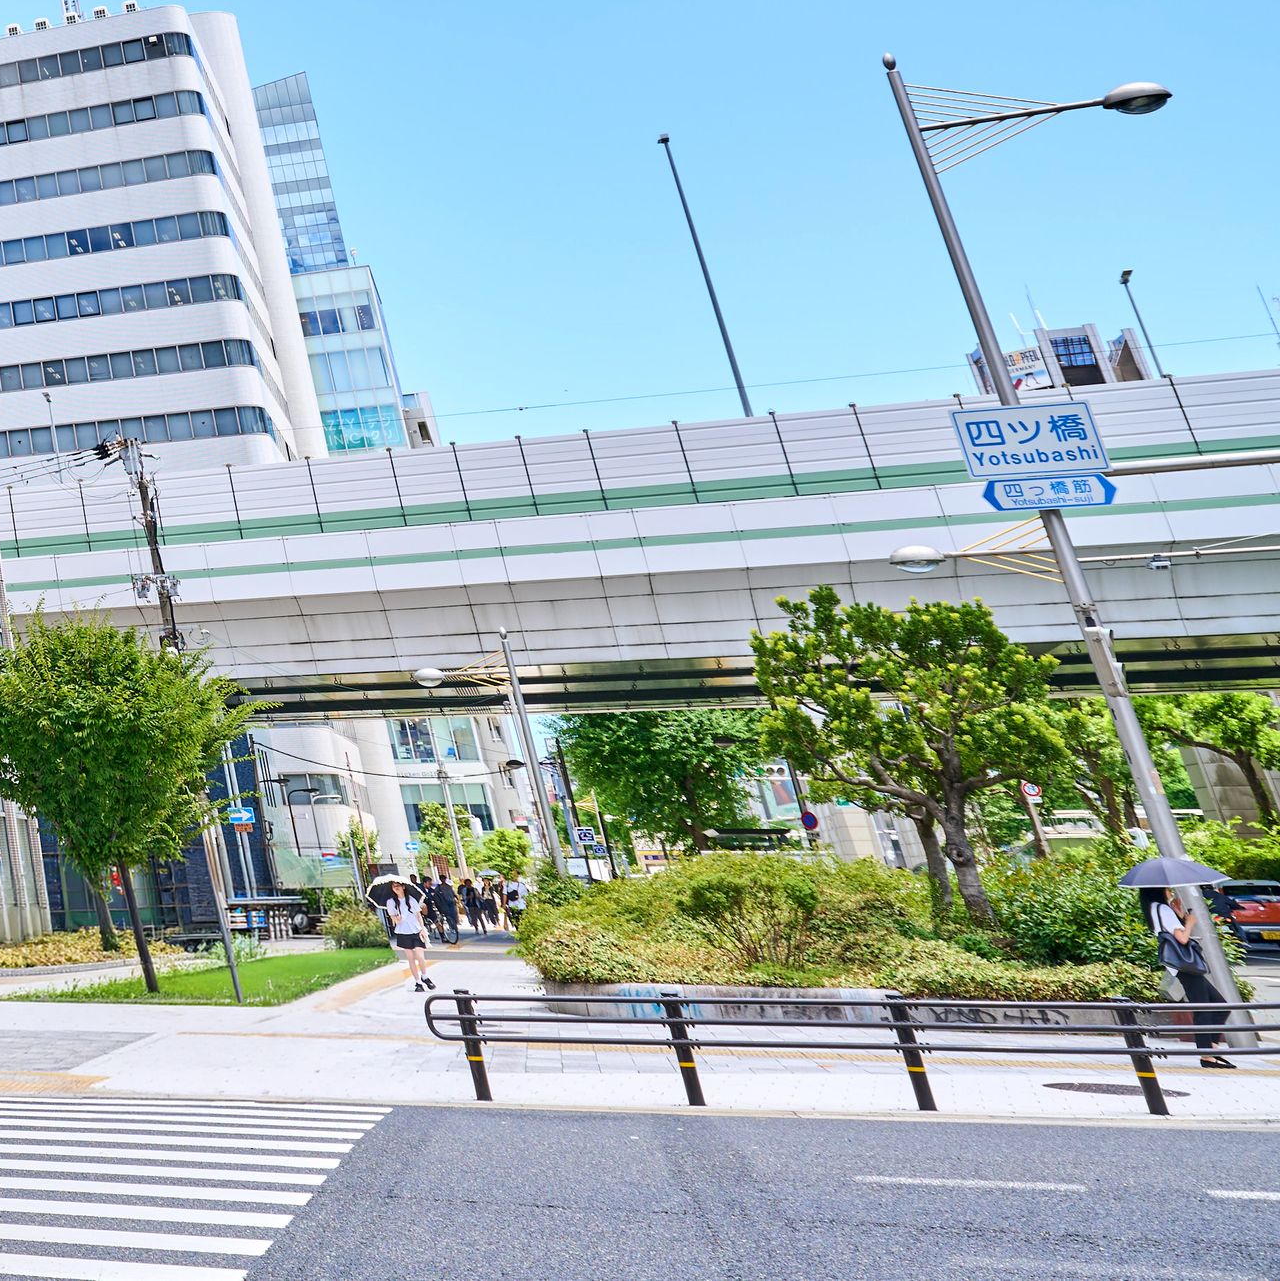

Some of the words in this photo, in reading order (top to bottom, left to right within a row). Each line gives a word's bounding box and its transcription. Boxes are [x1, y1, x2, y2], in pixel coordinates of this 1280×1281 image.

[965, 413, 1088, 447] 四ツ橋
[972, 444, 1099, 467] Yotsubashi
[1011, 495, 1095, 506] Yotsubashi-suji
